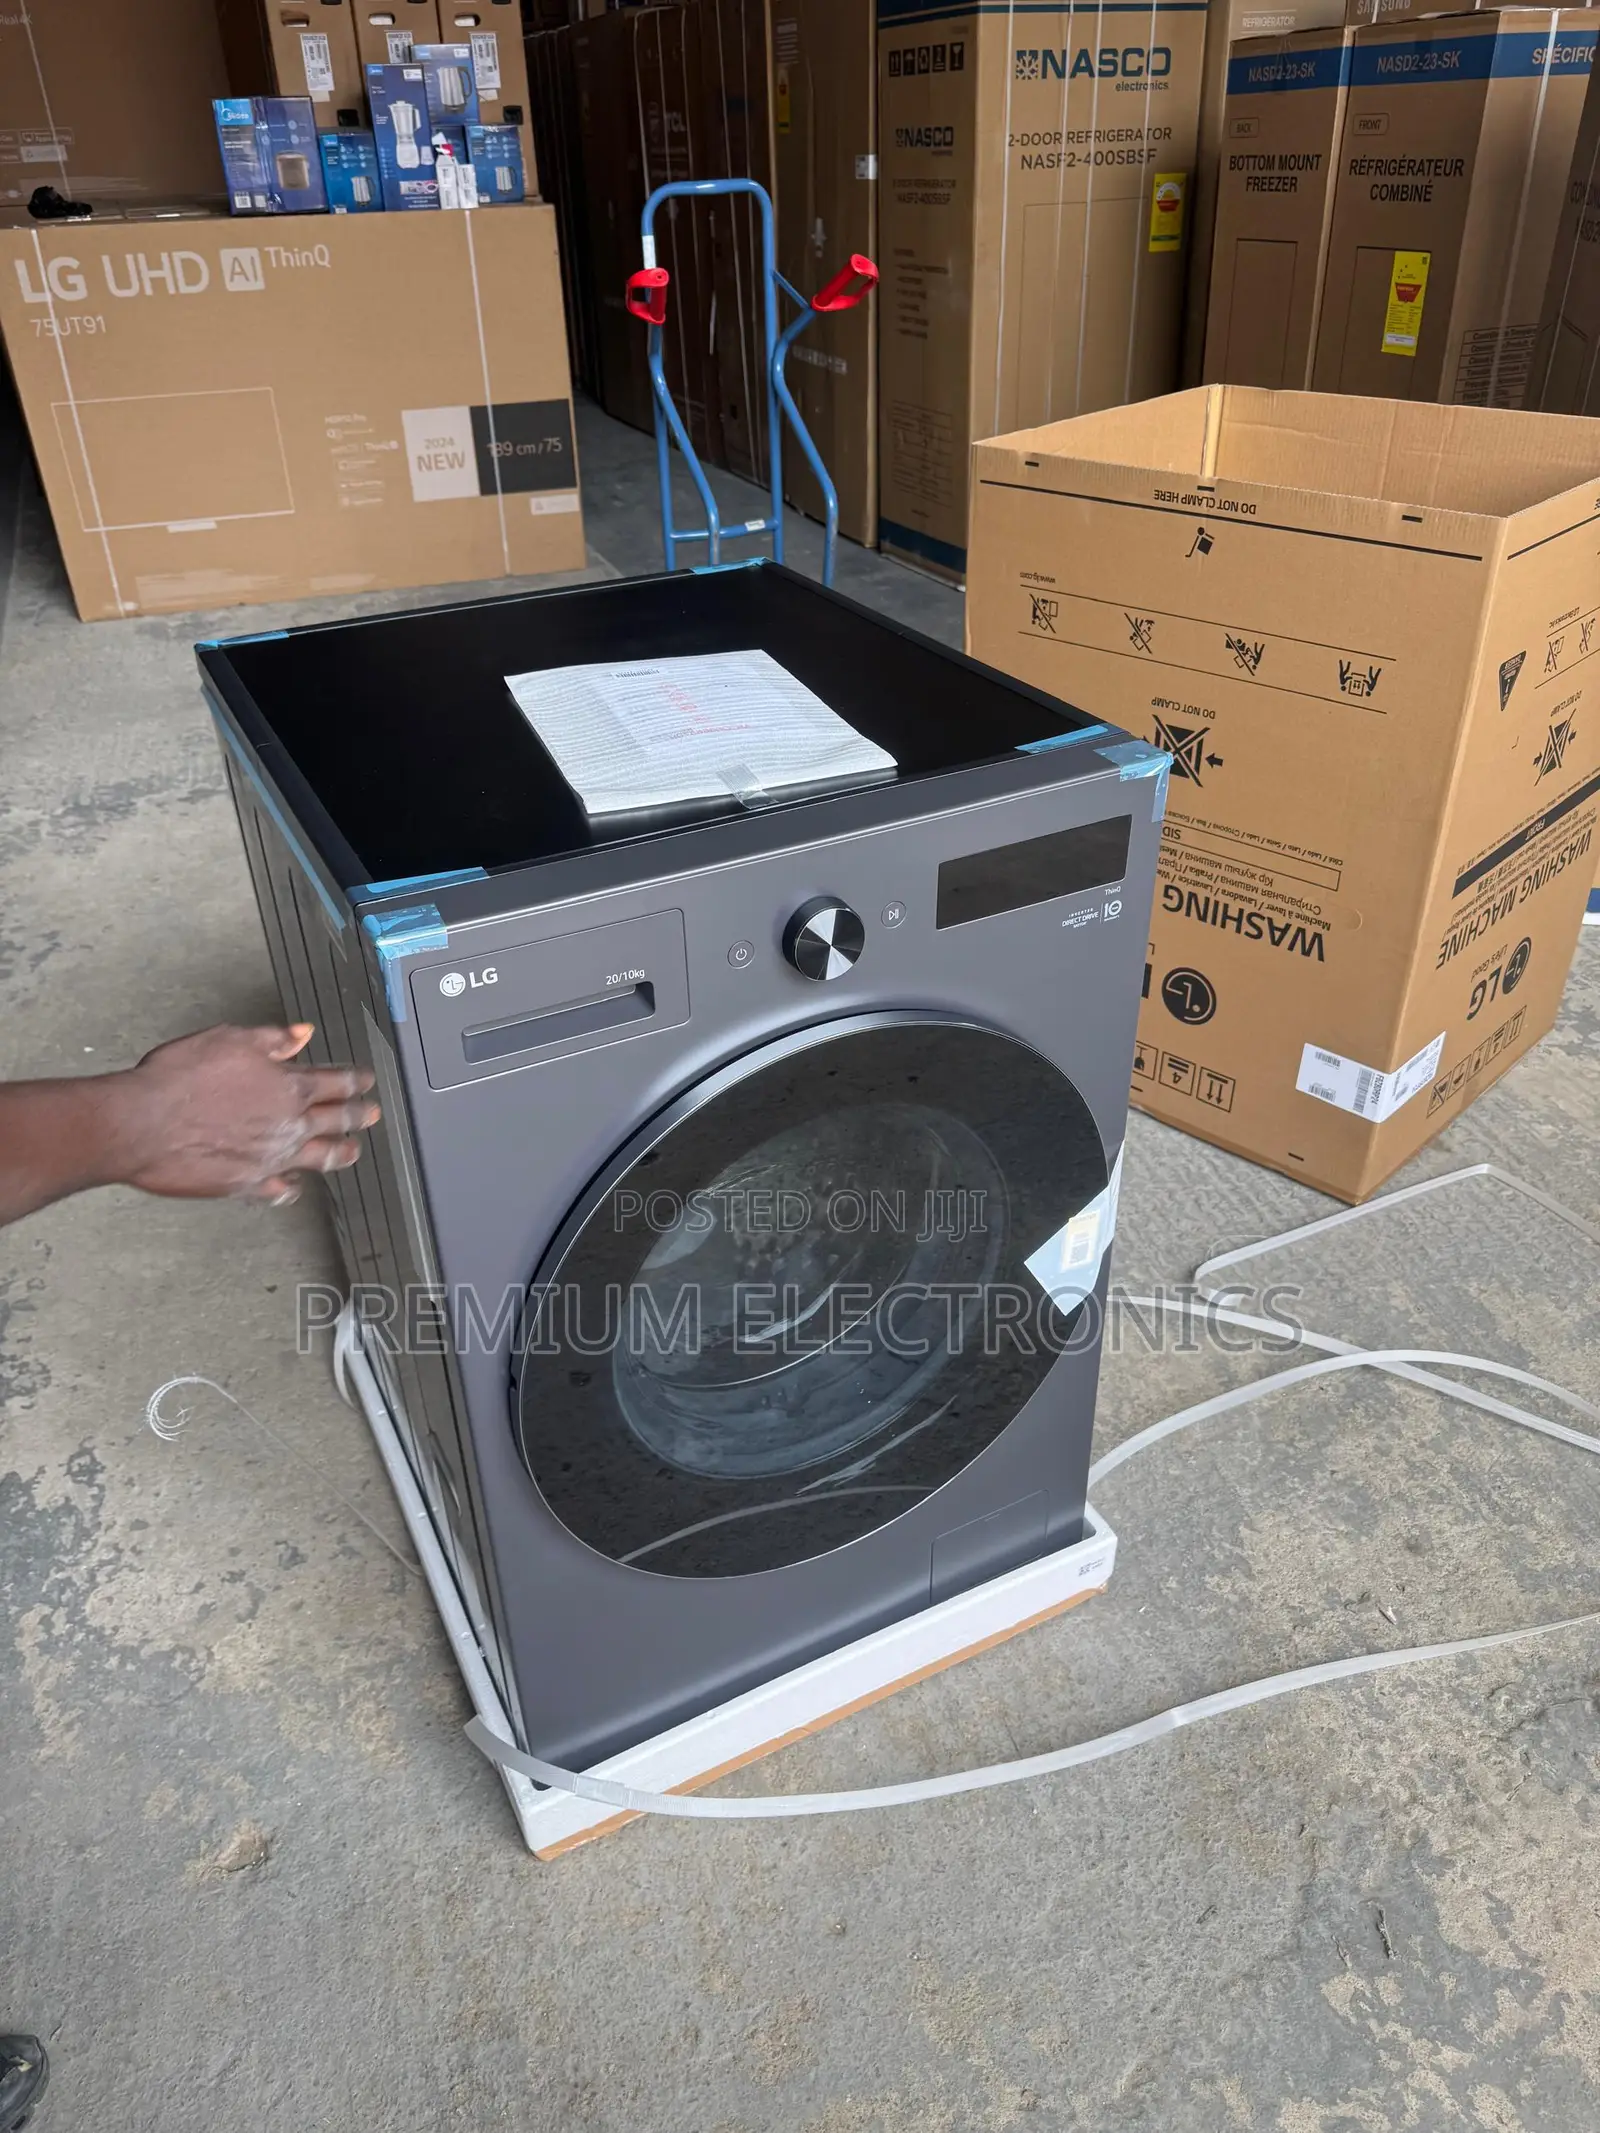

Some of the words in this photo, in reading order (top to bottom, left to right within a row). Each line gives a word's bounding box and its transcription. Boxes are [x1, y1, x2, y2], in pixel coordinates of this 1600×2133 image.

[1242, 16, 1295, 28] REFRIGERATOR
[1041, 47, 1172, 79] NASCO
[1377, 51, 1462, 73] NASD2-23-SK
[1248, 63, 1316, 83] NASD2-23-SK
[1115, 81, 1169, 92] electronics
[904, 126, 954, 148] NASCO
[1008, 132, 1063, 147] 2-DOOR
[1067, 127, 1172, 145] REFRIGERATOR
[1229, 155, 1276, 172] BOTTOM
[1277, 154, 1322, 171] MOUNT
[1349, 155, 1465, 177] RÉFRIGÉRATEUR
[1245, 177, 1298, 193] FREEZER
[1370, 180, 1434, 202] COMBINÉ
[14, 257, 88, 303] LG
[101, 251, 210, 298] UHD
[264, 244, 331, 268] ThinQ
[30, 315, 107, 338] 75UT91
[423, 437, 456, 450] 2024
[416, 452, 466, 472] NEW
[1154, 489, 1179, 503] HERE
[1181, 494, 1216, 509] CLAMP
[1217, 499, 1239, 512] NOT
[1241, 503, 1257, 515] DO
[1151, 697, 1180, 711] CLAMP
[1182, 704, 1201, 716] NOT
[1202, 709, 1216, 720] DO
[1185, 852, 1222, 870] машина
[1519, 828, 1592, 904] WASHING
[1221, 876, 1259, 894] машина
[1221, 888, 1258, 907] Lavadora
[1261, 888, 1321, 916] Стиральная
[1062, 915, 1082, 927] DIRECT
[1082, 911, 1099, 922] DRIVE
[1162, 884, 1325, 962] WASHING
[1295, 913, 1331, 932] Machine
[1436, 885, 1518, 971] MACHINE
[469, 967, 499, 989] LG
[606, 968, 645, 985] 20/10kg
[1466, 963, 1503, 1021] LG
